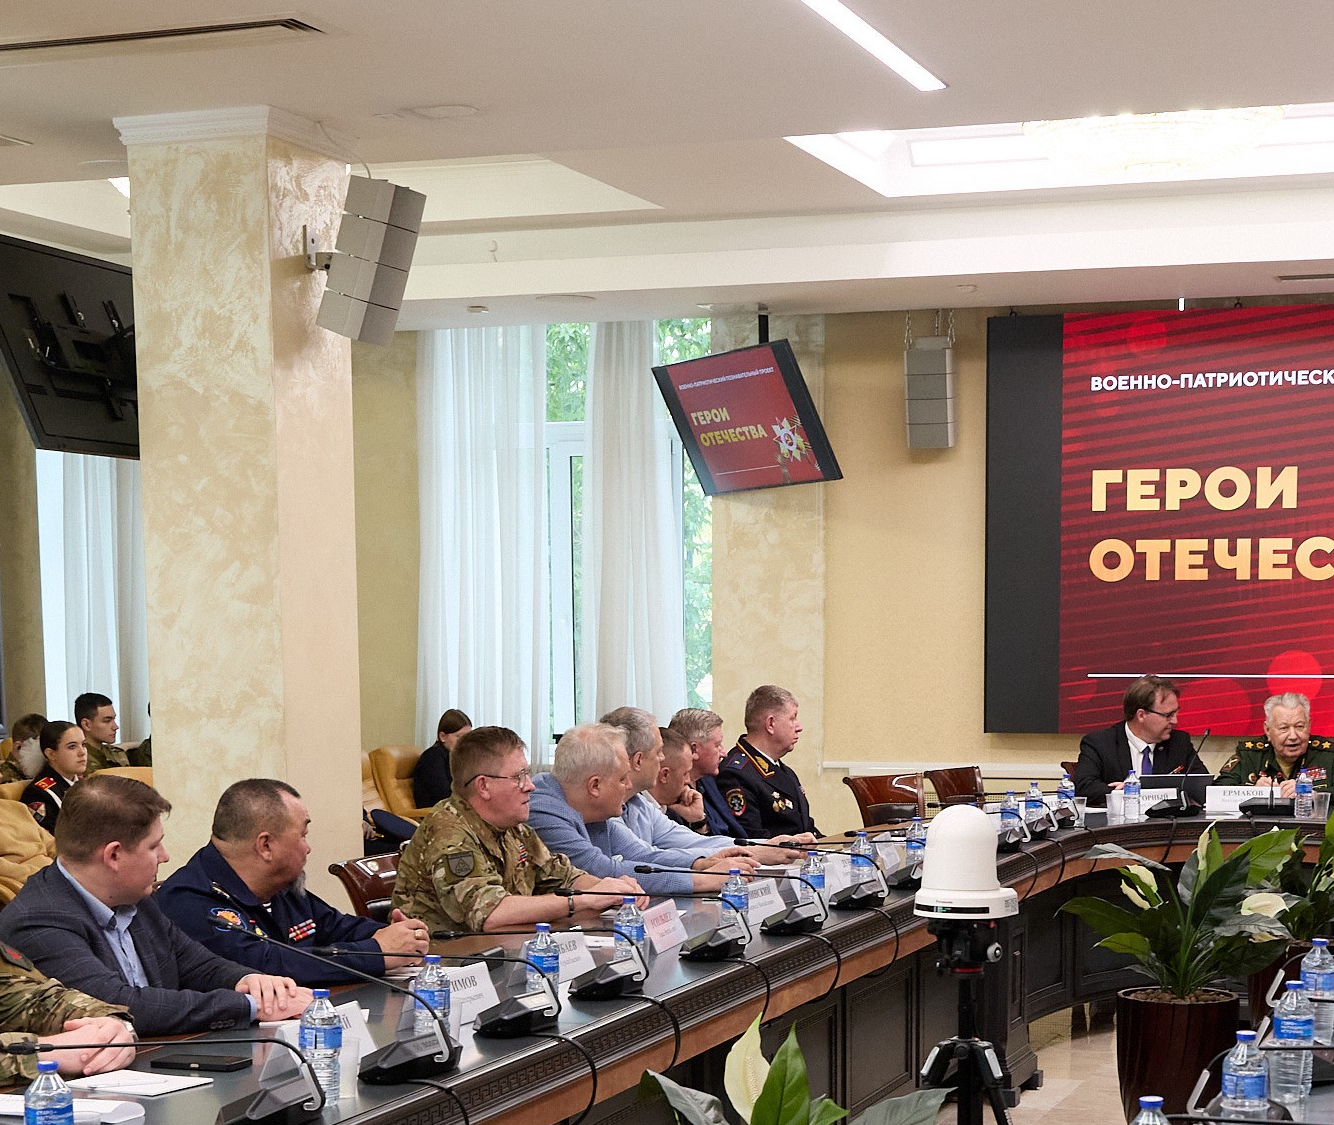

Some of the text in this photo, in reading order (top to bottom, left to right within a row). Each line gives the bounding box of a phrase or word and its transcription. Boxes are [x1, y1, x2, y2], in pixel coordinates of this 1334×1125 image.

[690, 407, 731, 426] ГЕРОИ
[700, 424, 768, 447] ОТЕЧЕСТВА
[1090, 466, 1298, 512] ГЕРОИ
